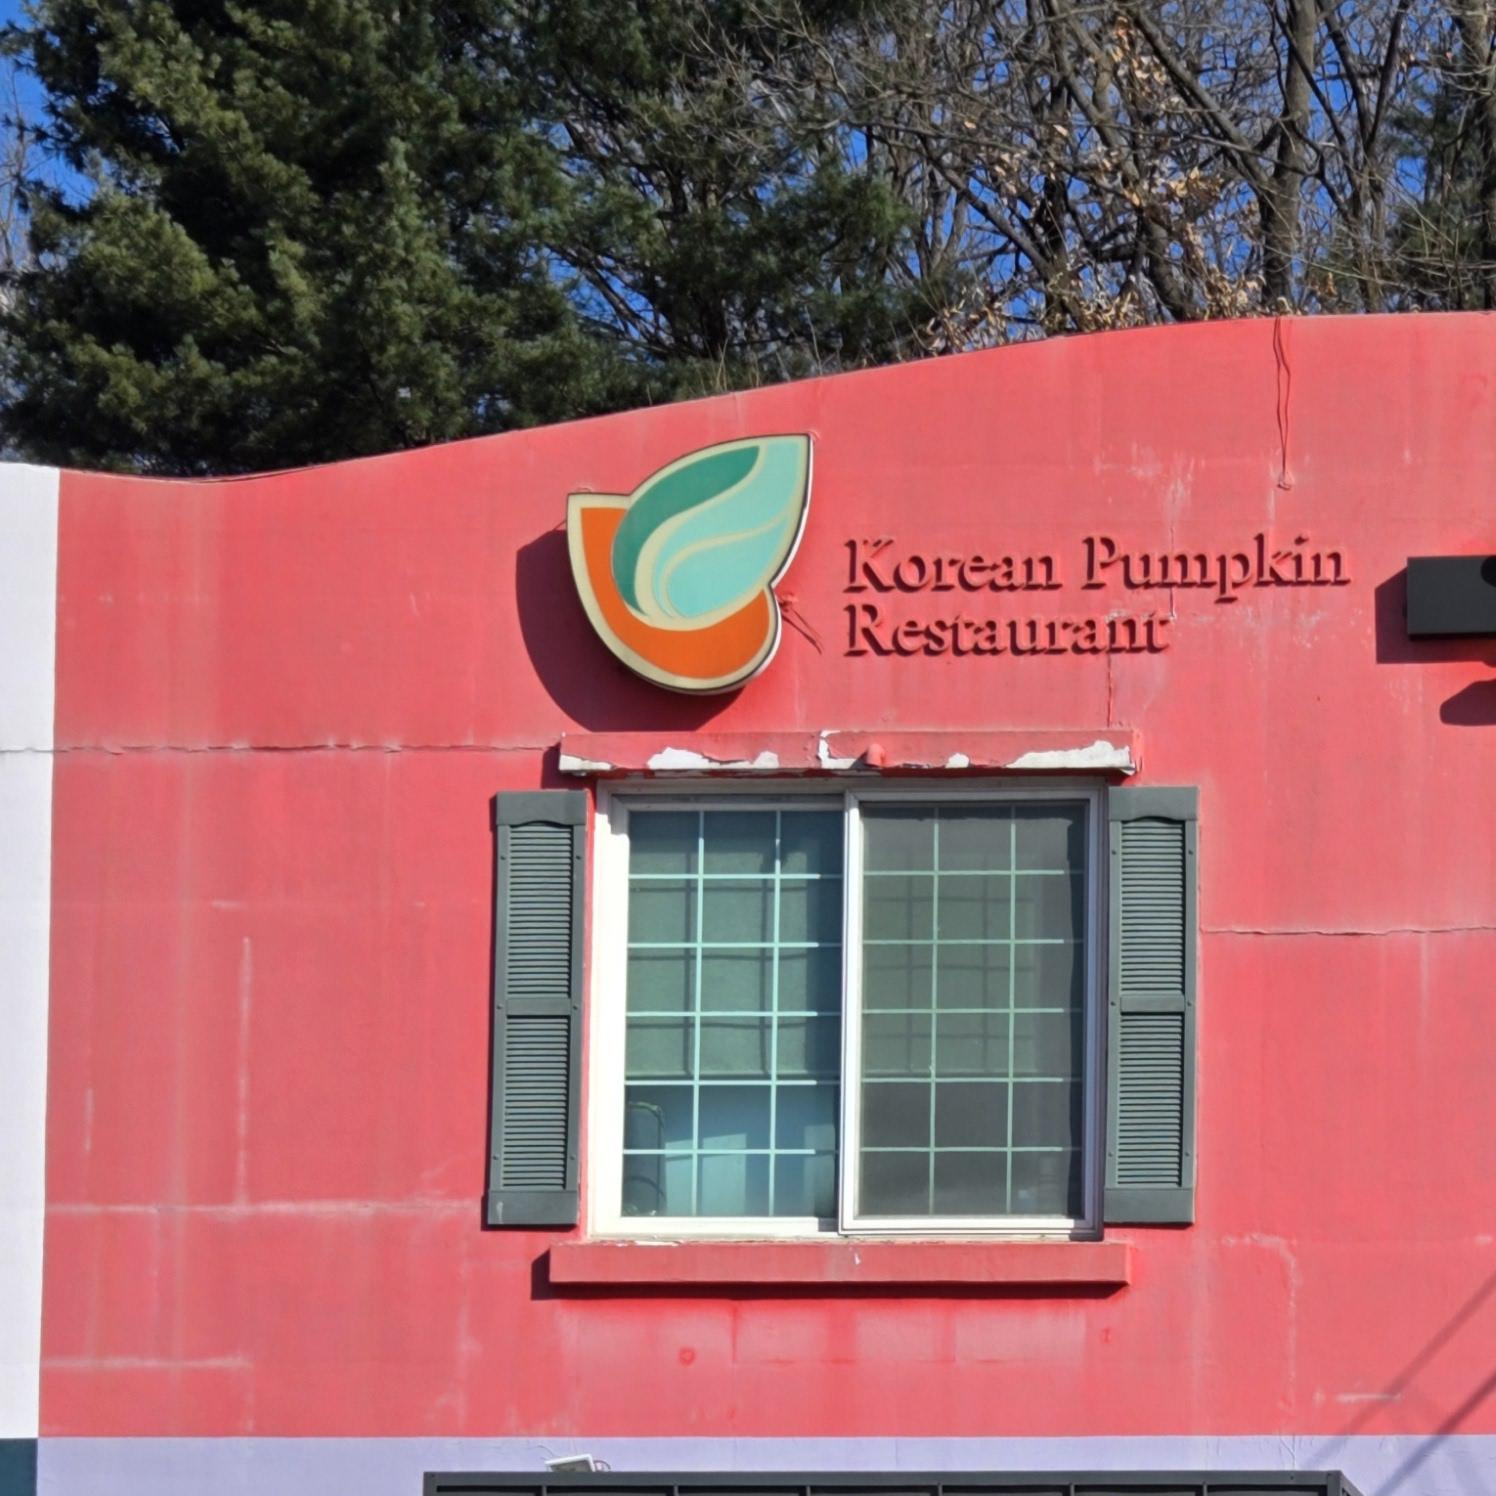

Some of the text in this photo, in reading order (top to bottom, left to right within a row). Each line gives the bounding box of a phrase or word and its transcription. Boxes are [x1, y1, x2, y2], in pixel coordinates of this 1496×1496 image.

[843, 532, 1351, 604] Korean Pumpkin
[843, 602, 1171, 658] Restaurant
